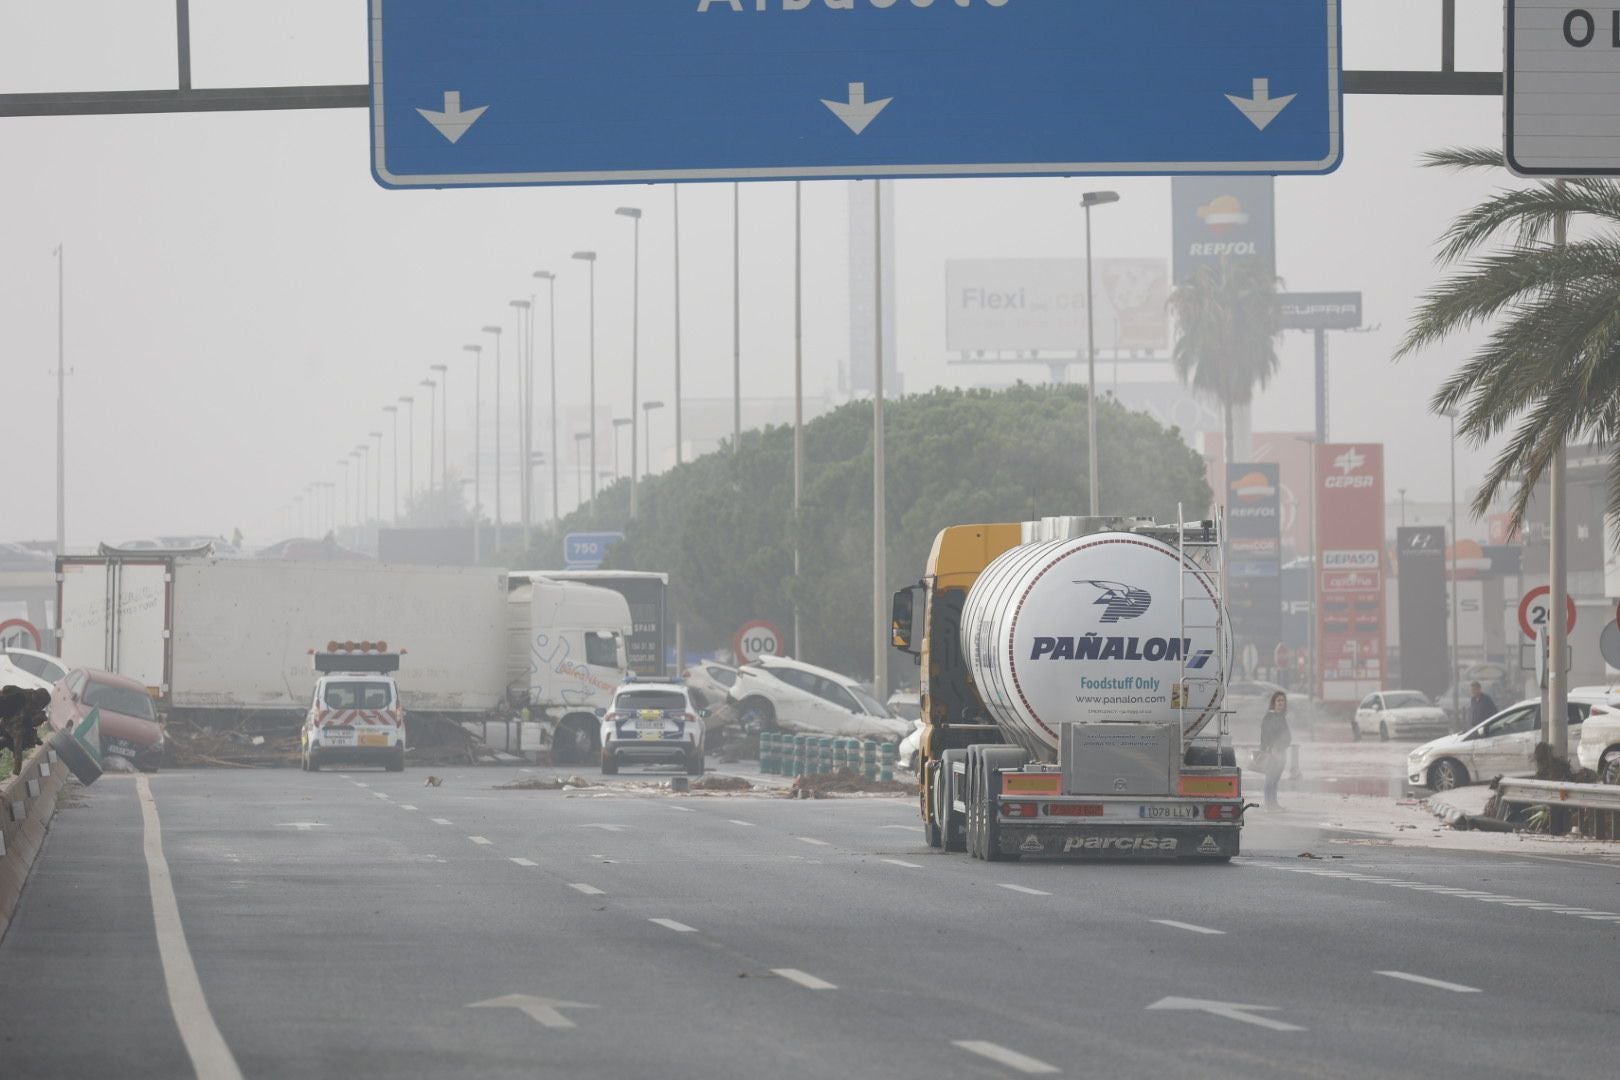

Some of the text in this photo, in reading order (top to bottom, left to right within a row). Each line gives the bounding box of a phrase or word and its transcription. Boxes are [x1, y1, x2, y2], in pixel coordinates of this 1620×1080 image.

[1190, 241, 1256, 257] REPSOL
[961, 287, 1025, 310] Flexi
[1325, 475, 1374, 489] CEPSA
[1230, 506, 1275, 517] REPSOL
[573, 542, 598, 555] 750
[1532, 606, 1550, 624] 2
[744, 637, 775, 653] 100
[1030, 632, 1191, 662] PAÑALON
[1080, 676, 1160, 693] Foodstuff Only
[1075, 694, 1166, 706] www.panalon.com
[1173, 806, 1192, 817] LLY
[1063, 834, 1178, 853] parcisa
